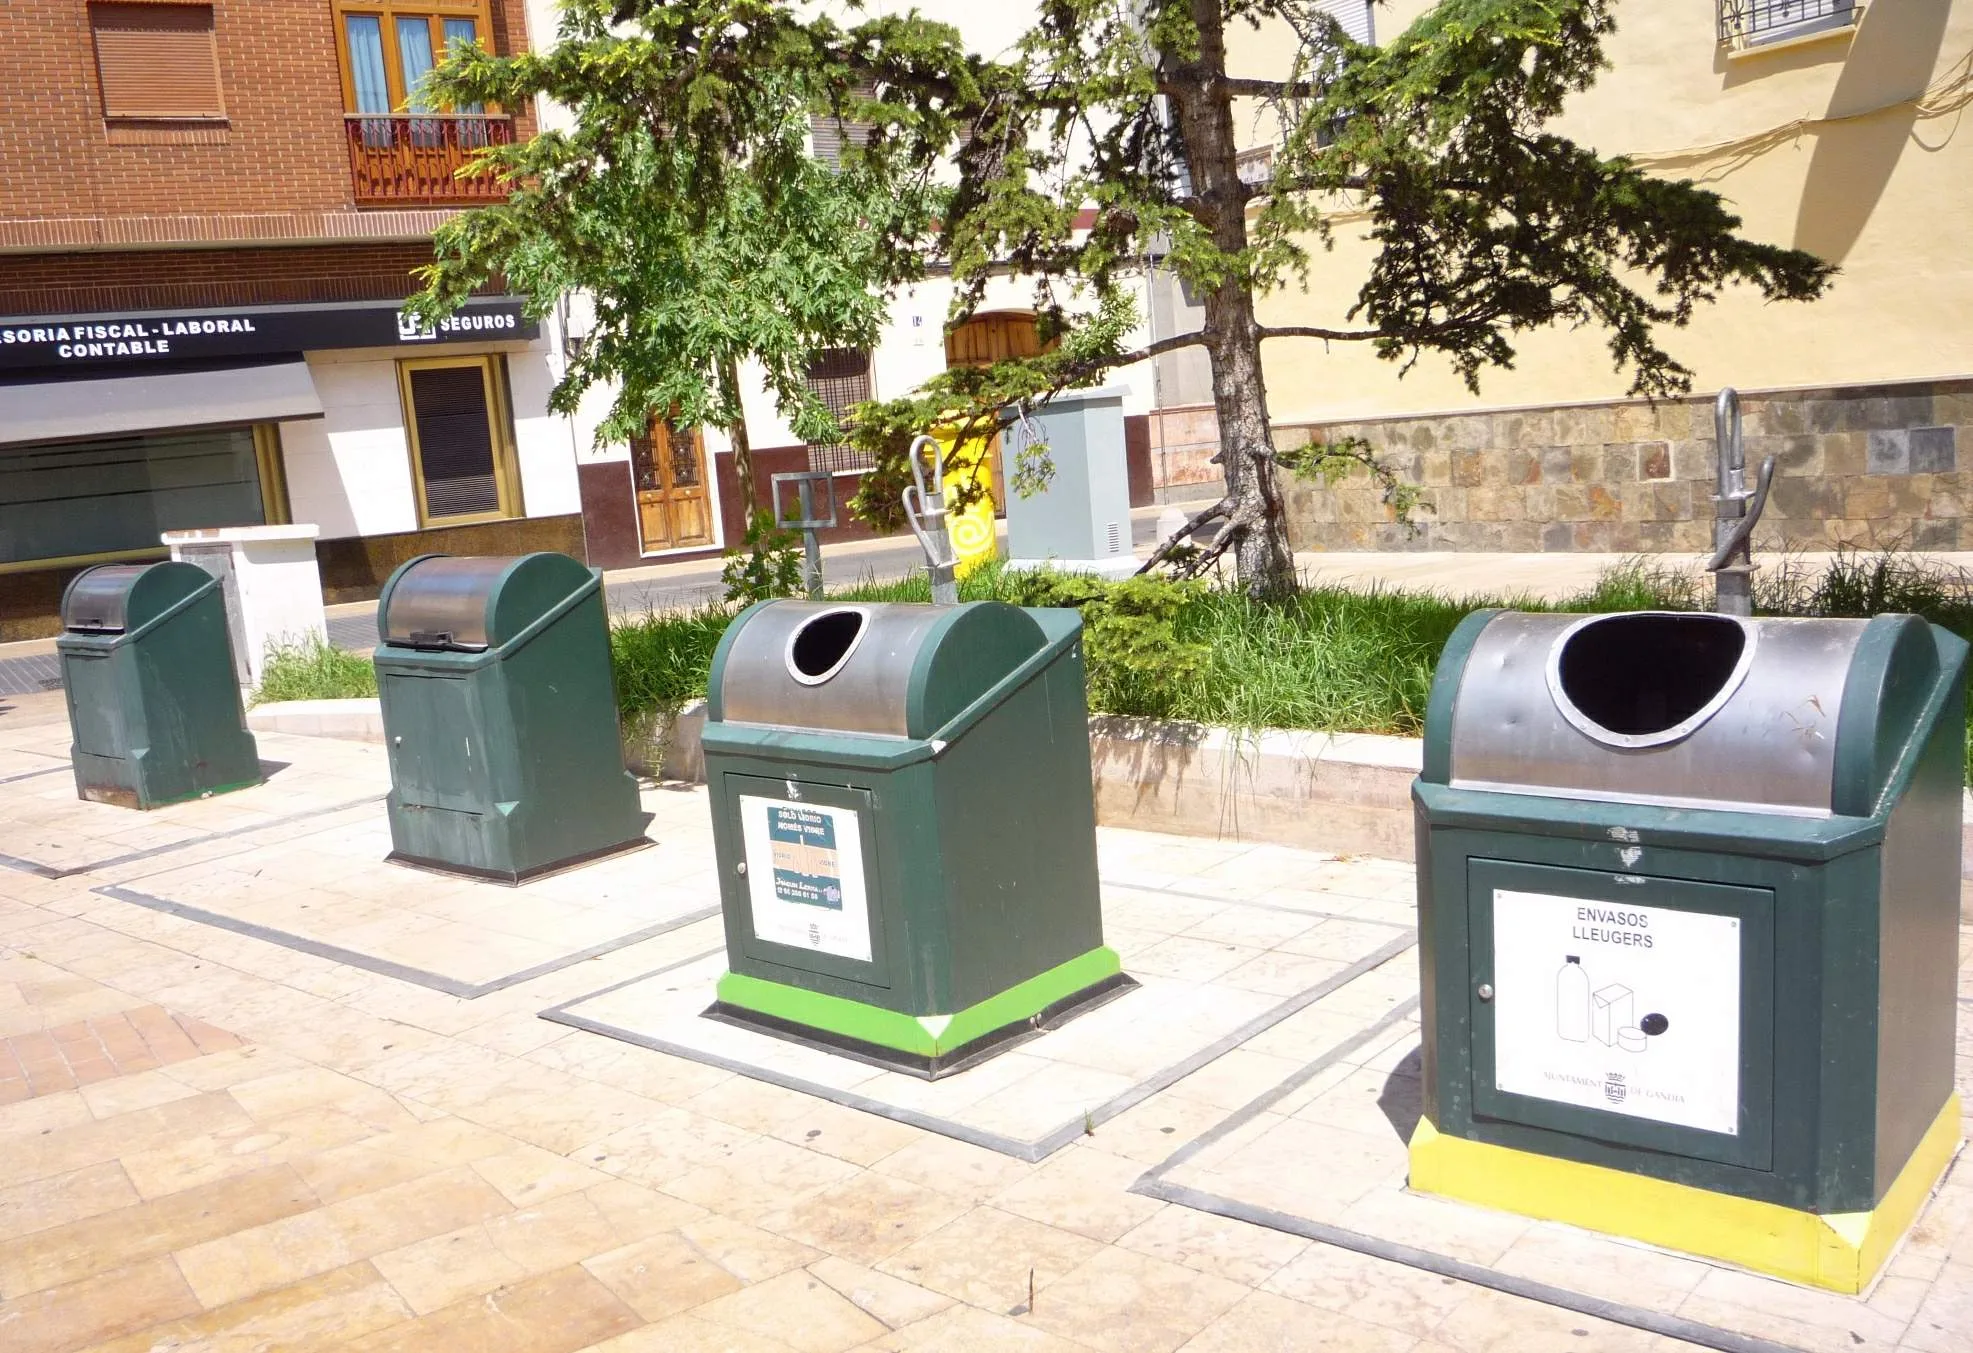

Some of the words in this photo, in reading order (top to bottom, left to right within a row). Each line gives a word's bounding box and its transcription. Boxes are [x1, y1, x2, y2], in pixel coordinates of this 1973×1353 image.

[0, 327, 70, 344] SORIA
[74, 324, 149, 340] FISCAL
[163, 319, 256, 336] LABORAL
[440, 314, 516, 331] SEGUROS
[58, 340, 170, 358] CONTABLE
[1577, 907, 1649, 929] ENVASOS
[1572, 925, 1653, 949] LLEUGERS
